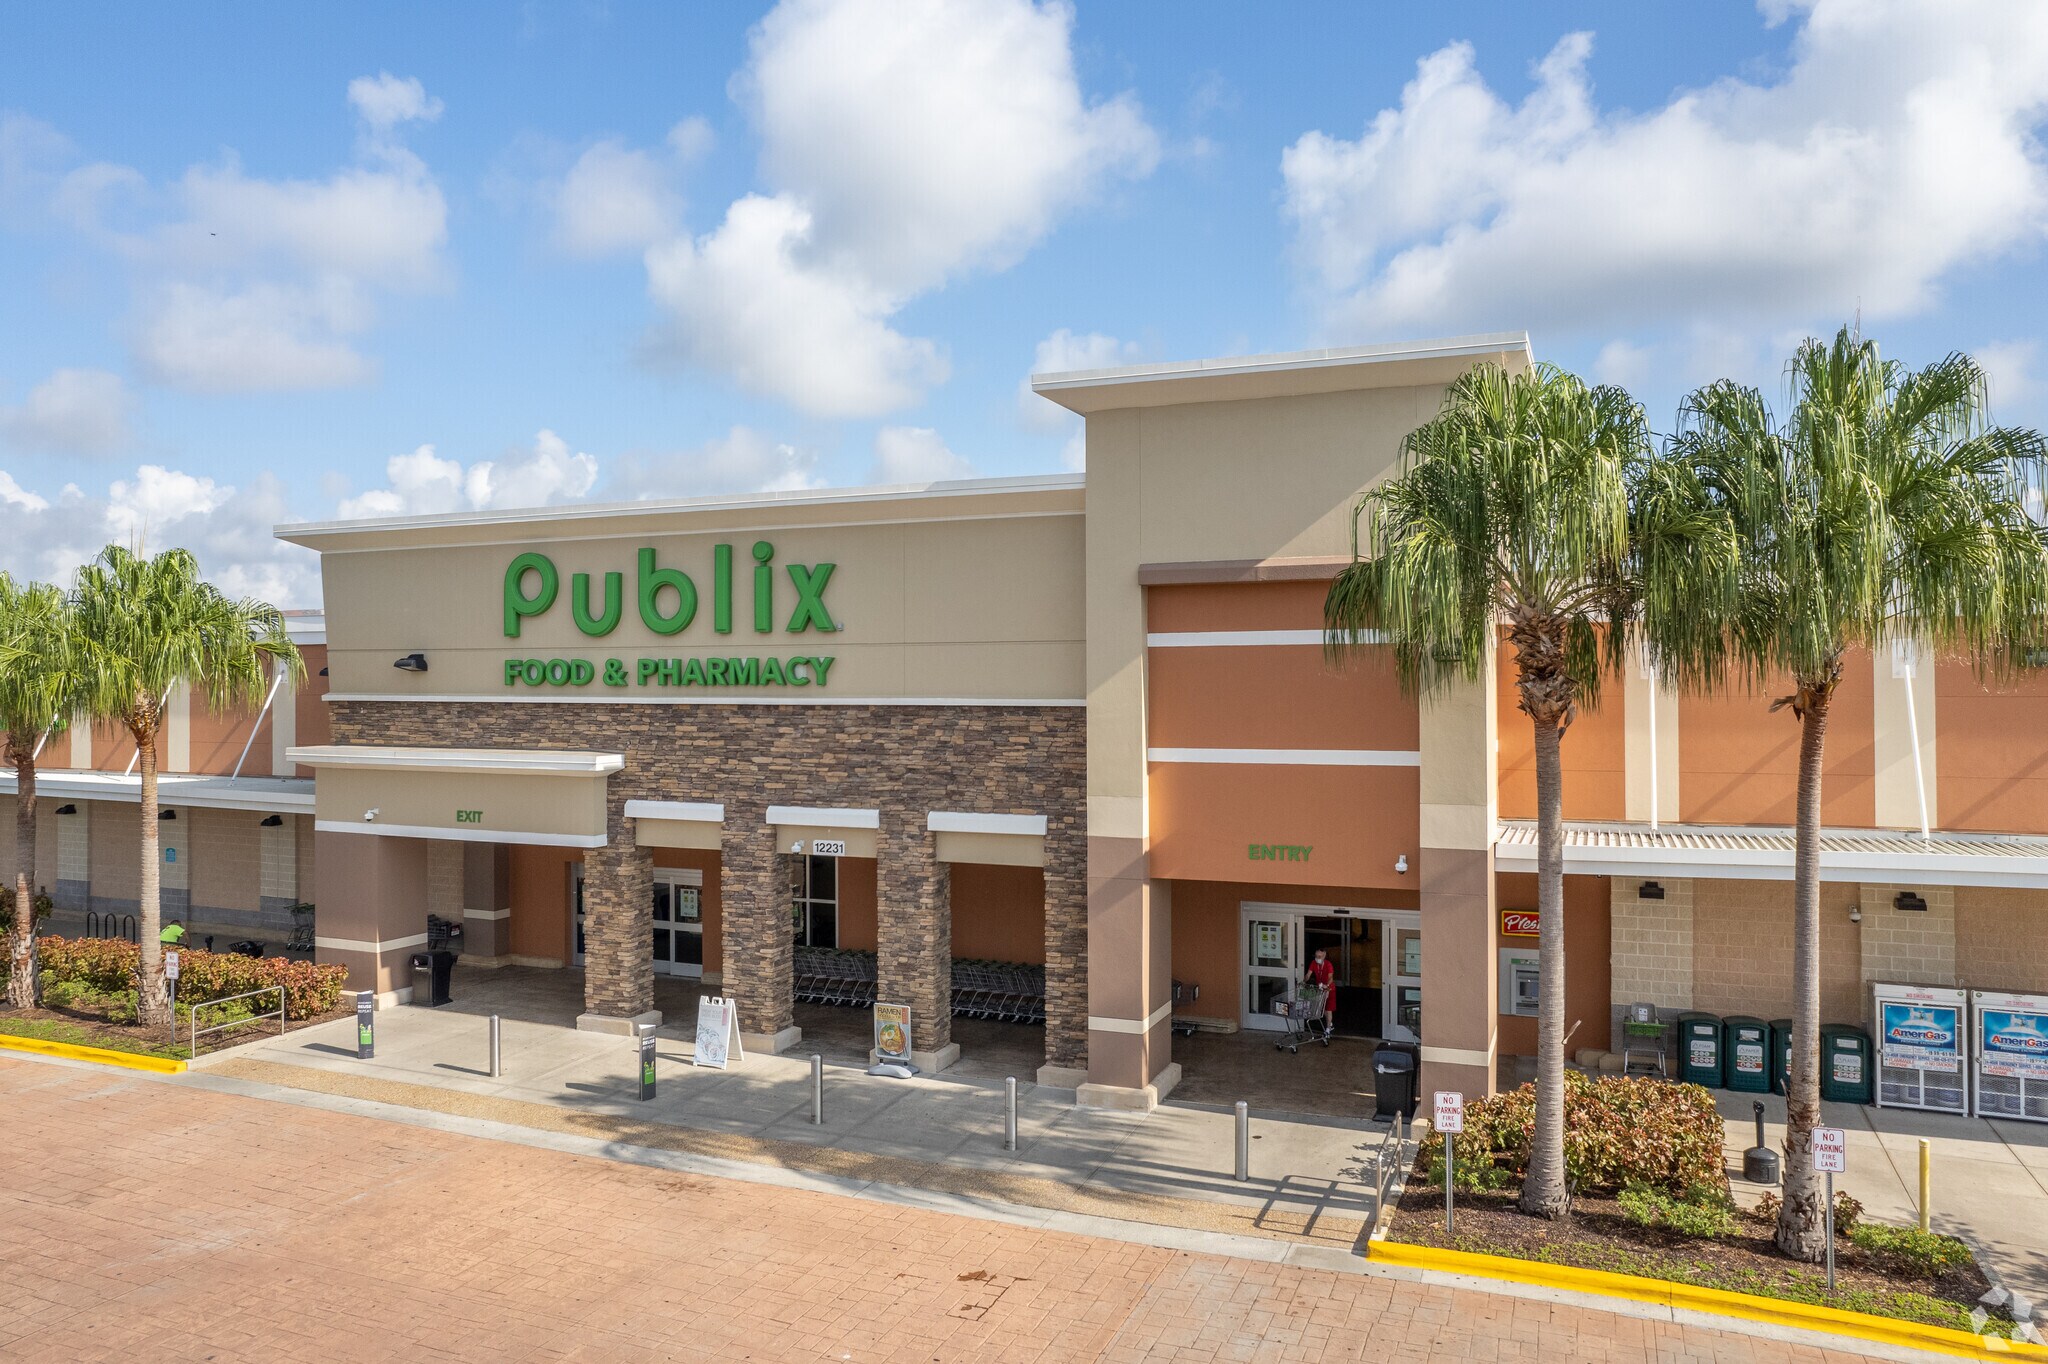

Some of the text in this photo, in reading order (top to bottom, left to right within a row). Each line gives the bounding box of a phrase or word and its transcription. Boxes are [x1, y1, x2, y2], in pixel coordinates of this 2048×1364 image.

[504, 541, 837, 638] Publix
[504, 656, 836, 687] FOOD & PHARMACY
[456, 810, 484, 823] EXIT
[815, 842, 844, 854] 12231
[1248, 844, 1313, 862] ENTRY
[877, 1006, 902, 1016] RAMEN
[1892, 1028, 1947, 1041] AmeriGas
[1992, 1035, 2048, 1048] AmeriGas
[1443, 1096, 1454, 1105] NO
[1436, 1106, 1461, 1115] PARKING
[1822, 1133, 1835, 1142] NO
[1815, 1143, 1843, 1154] PARKING
